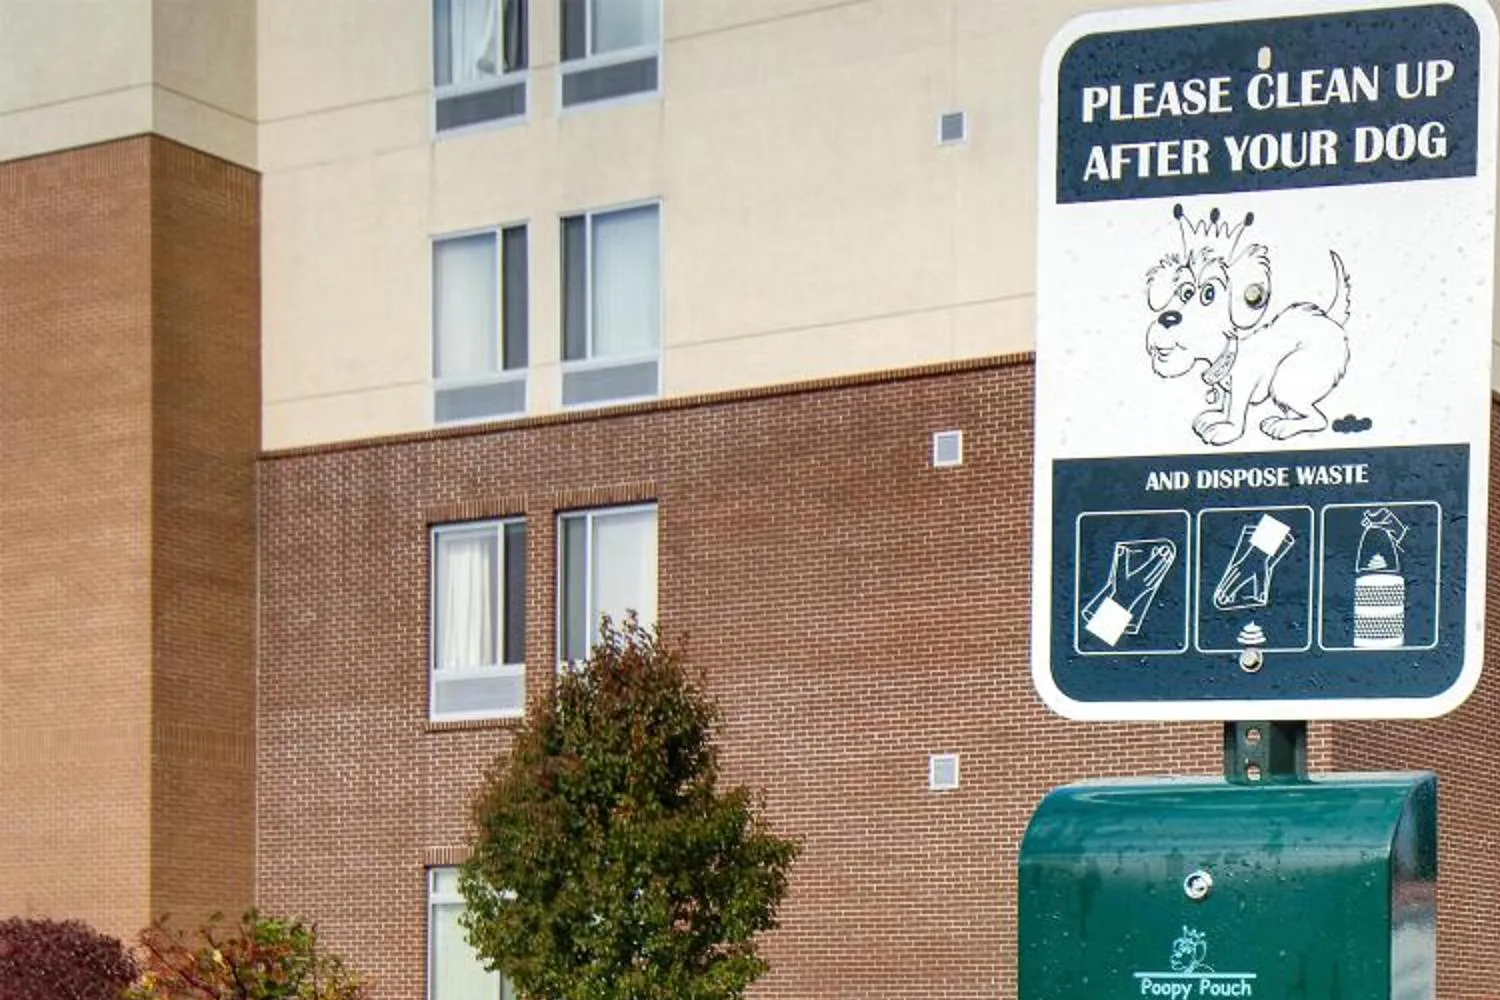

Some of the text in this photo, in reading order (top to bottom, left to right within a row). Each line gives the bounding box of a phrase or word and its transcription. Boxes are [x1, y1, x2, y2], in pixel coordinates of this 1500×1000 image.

[1082, 59, 1455, 123] PLEASE CLEAN UP
[1082, 121, 1448, 182] AFTER YOUR DOG
[1145, 463, 1369, 491] AND DISPOSE WASTE
[1141, 978, 1252, 1000] Poopy Pouch
